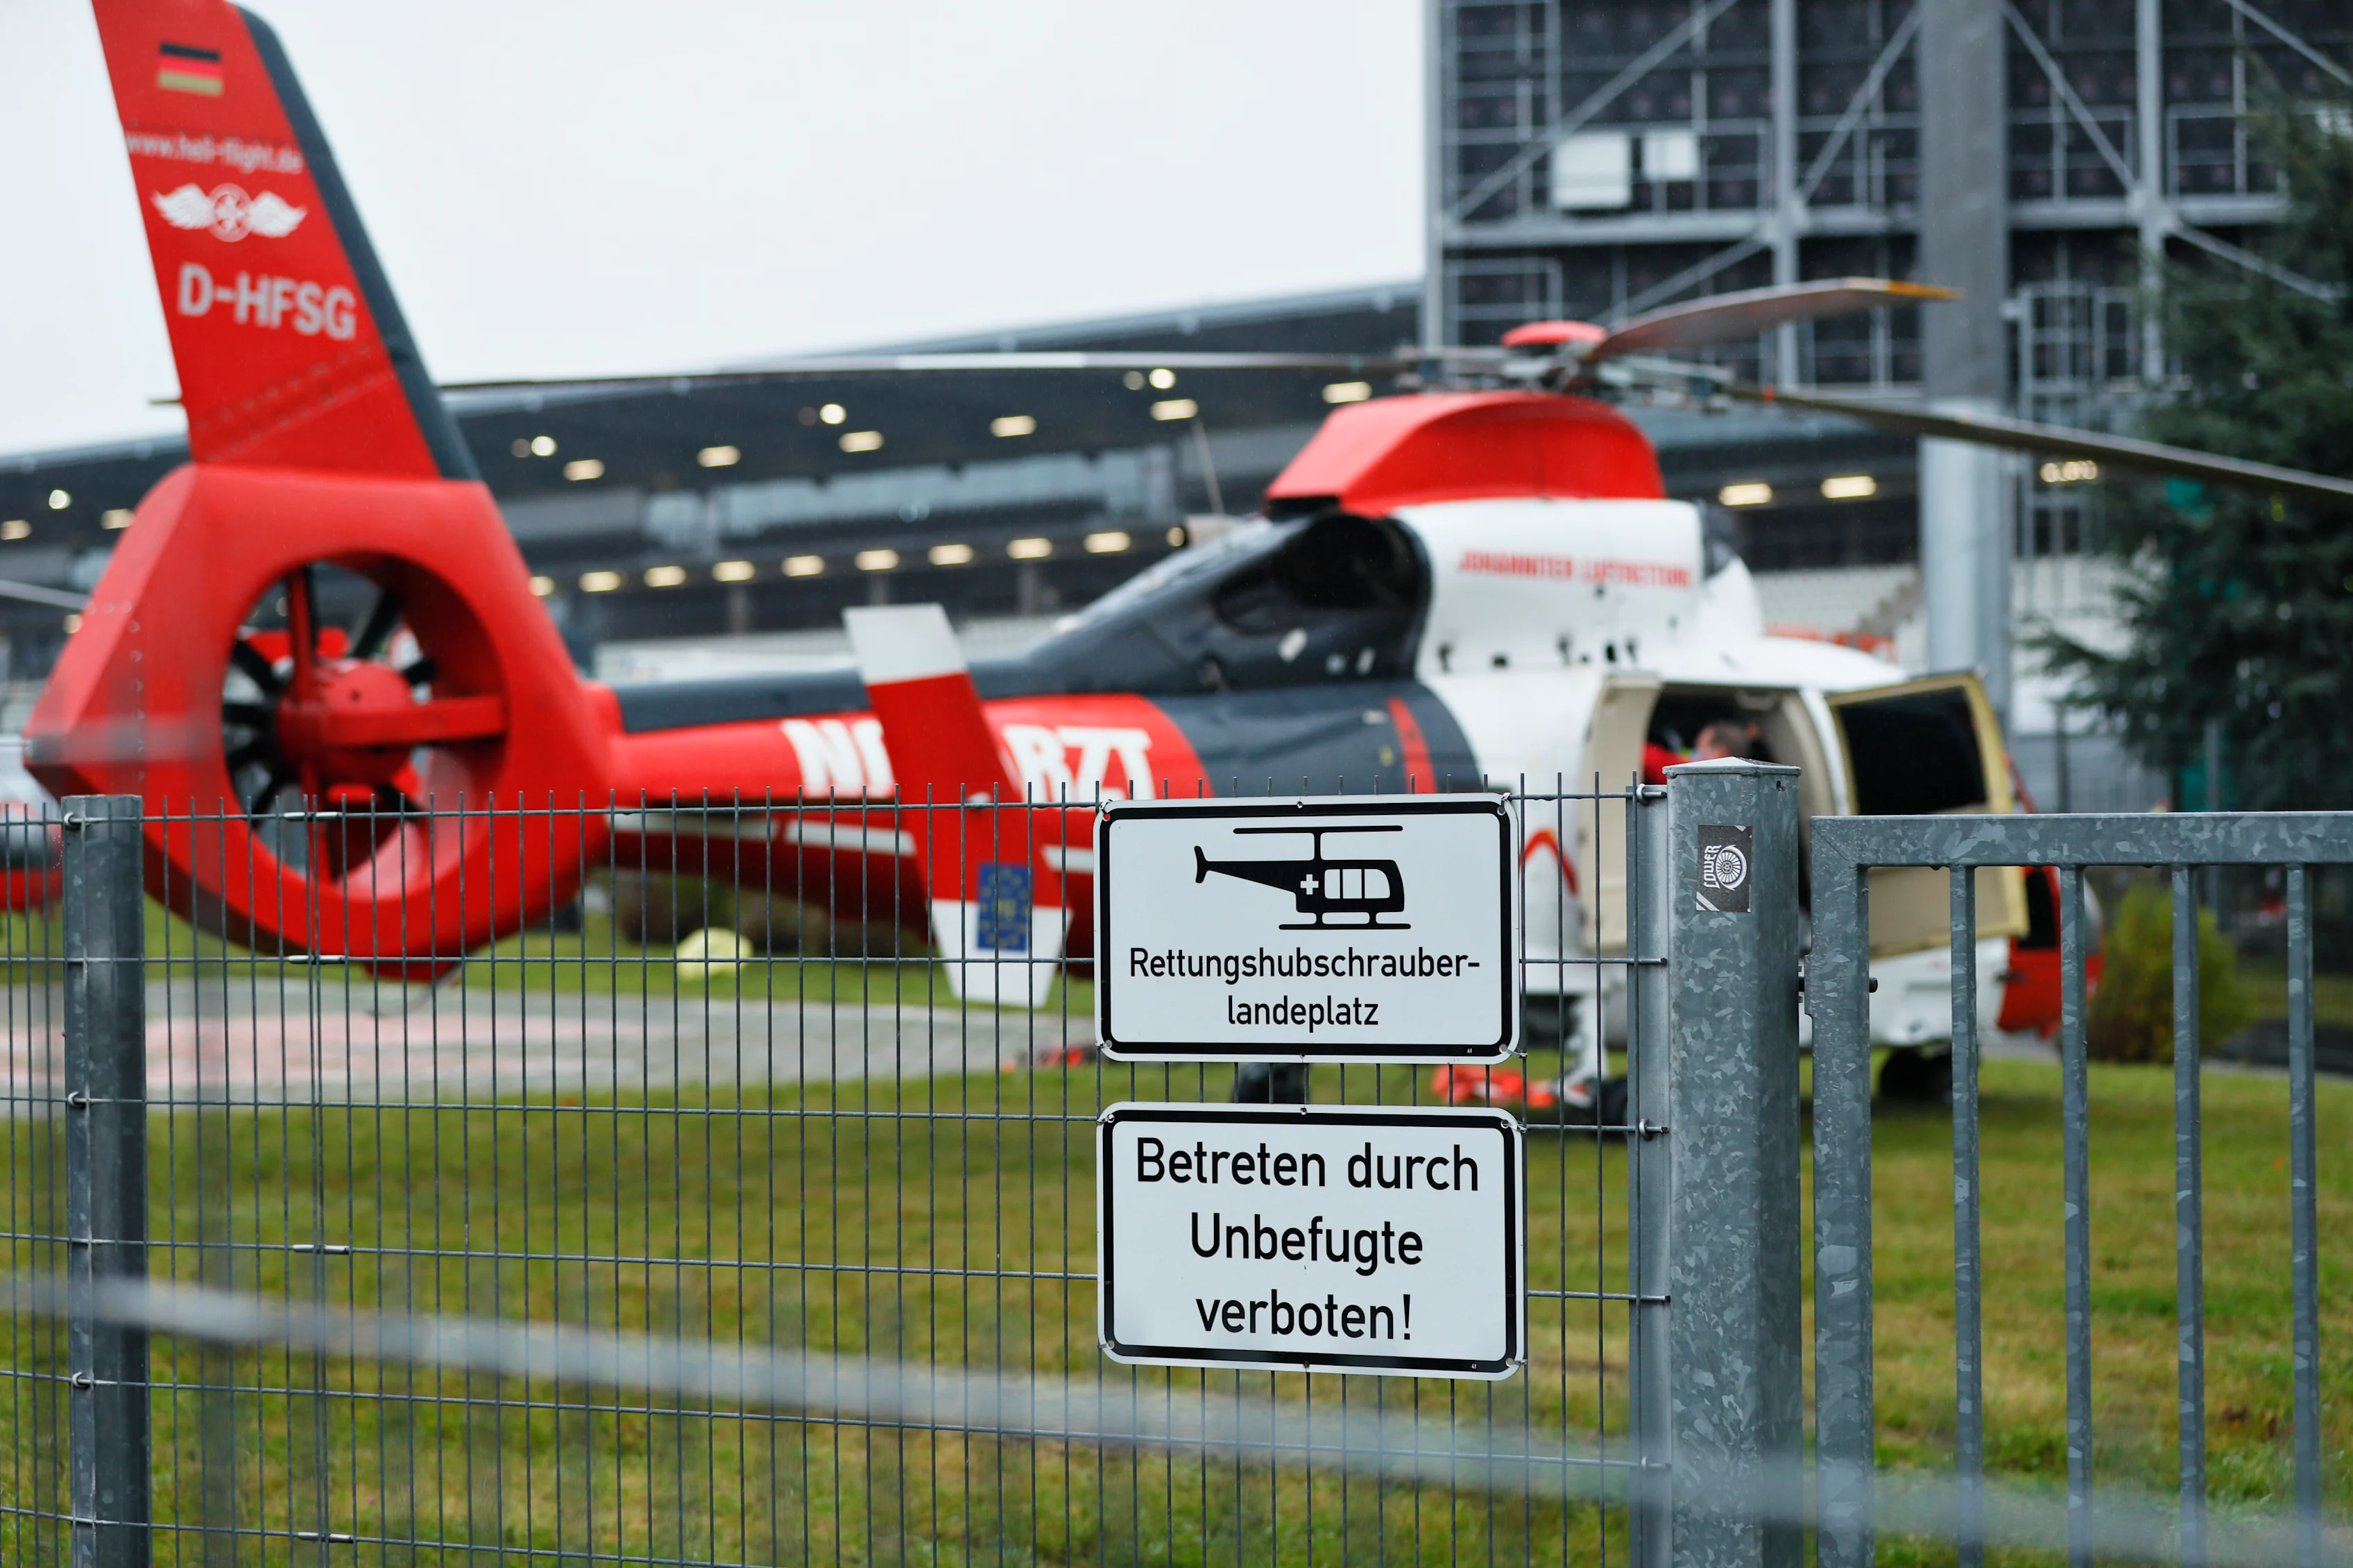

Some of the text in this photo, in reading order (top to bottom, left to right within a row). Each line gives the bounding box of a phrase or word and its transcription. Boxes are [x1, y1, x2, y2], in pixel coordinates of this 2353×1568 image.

[178, 261, 357, 341] D-HFSG
[1704, 845, 1722, 888] LOWER
[1130, 947, 1480, 985] Rettungshubschrauber-
[1228, 994, 1378, 1033] landeplatz
[1137, 1137, 1478, 1191] Betreten durch
[1191, 1212, 1423, 1277] Unbefugte
[1195, 1289, 1411, 1341] verboten!
